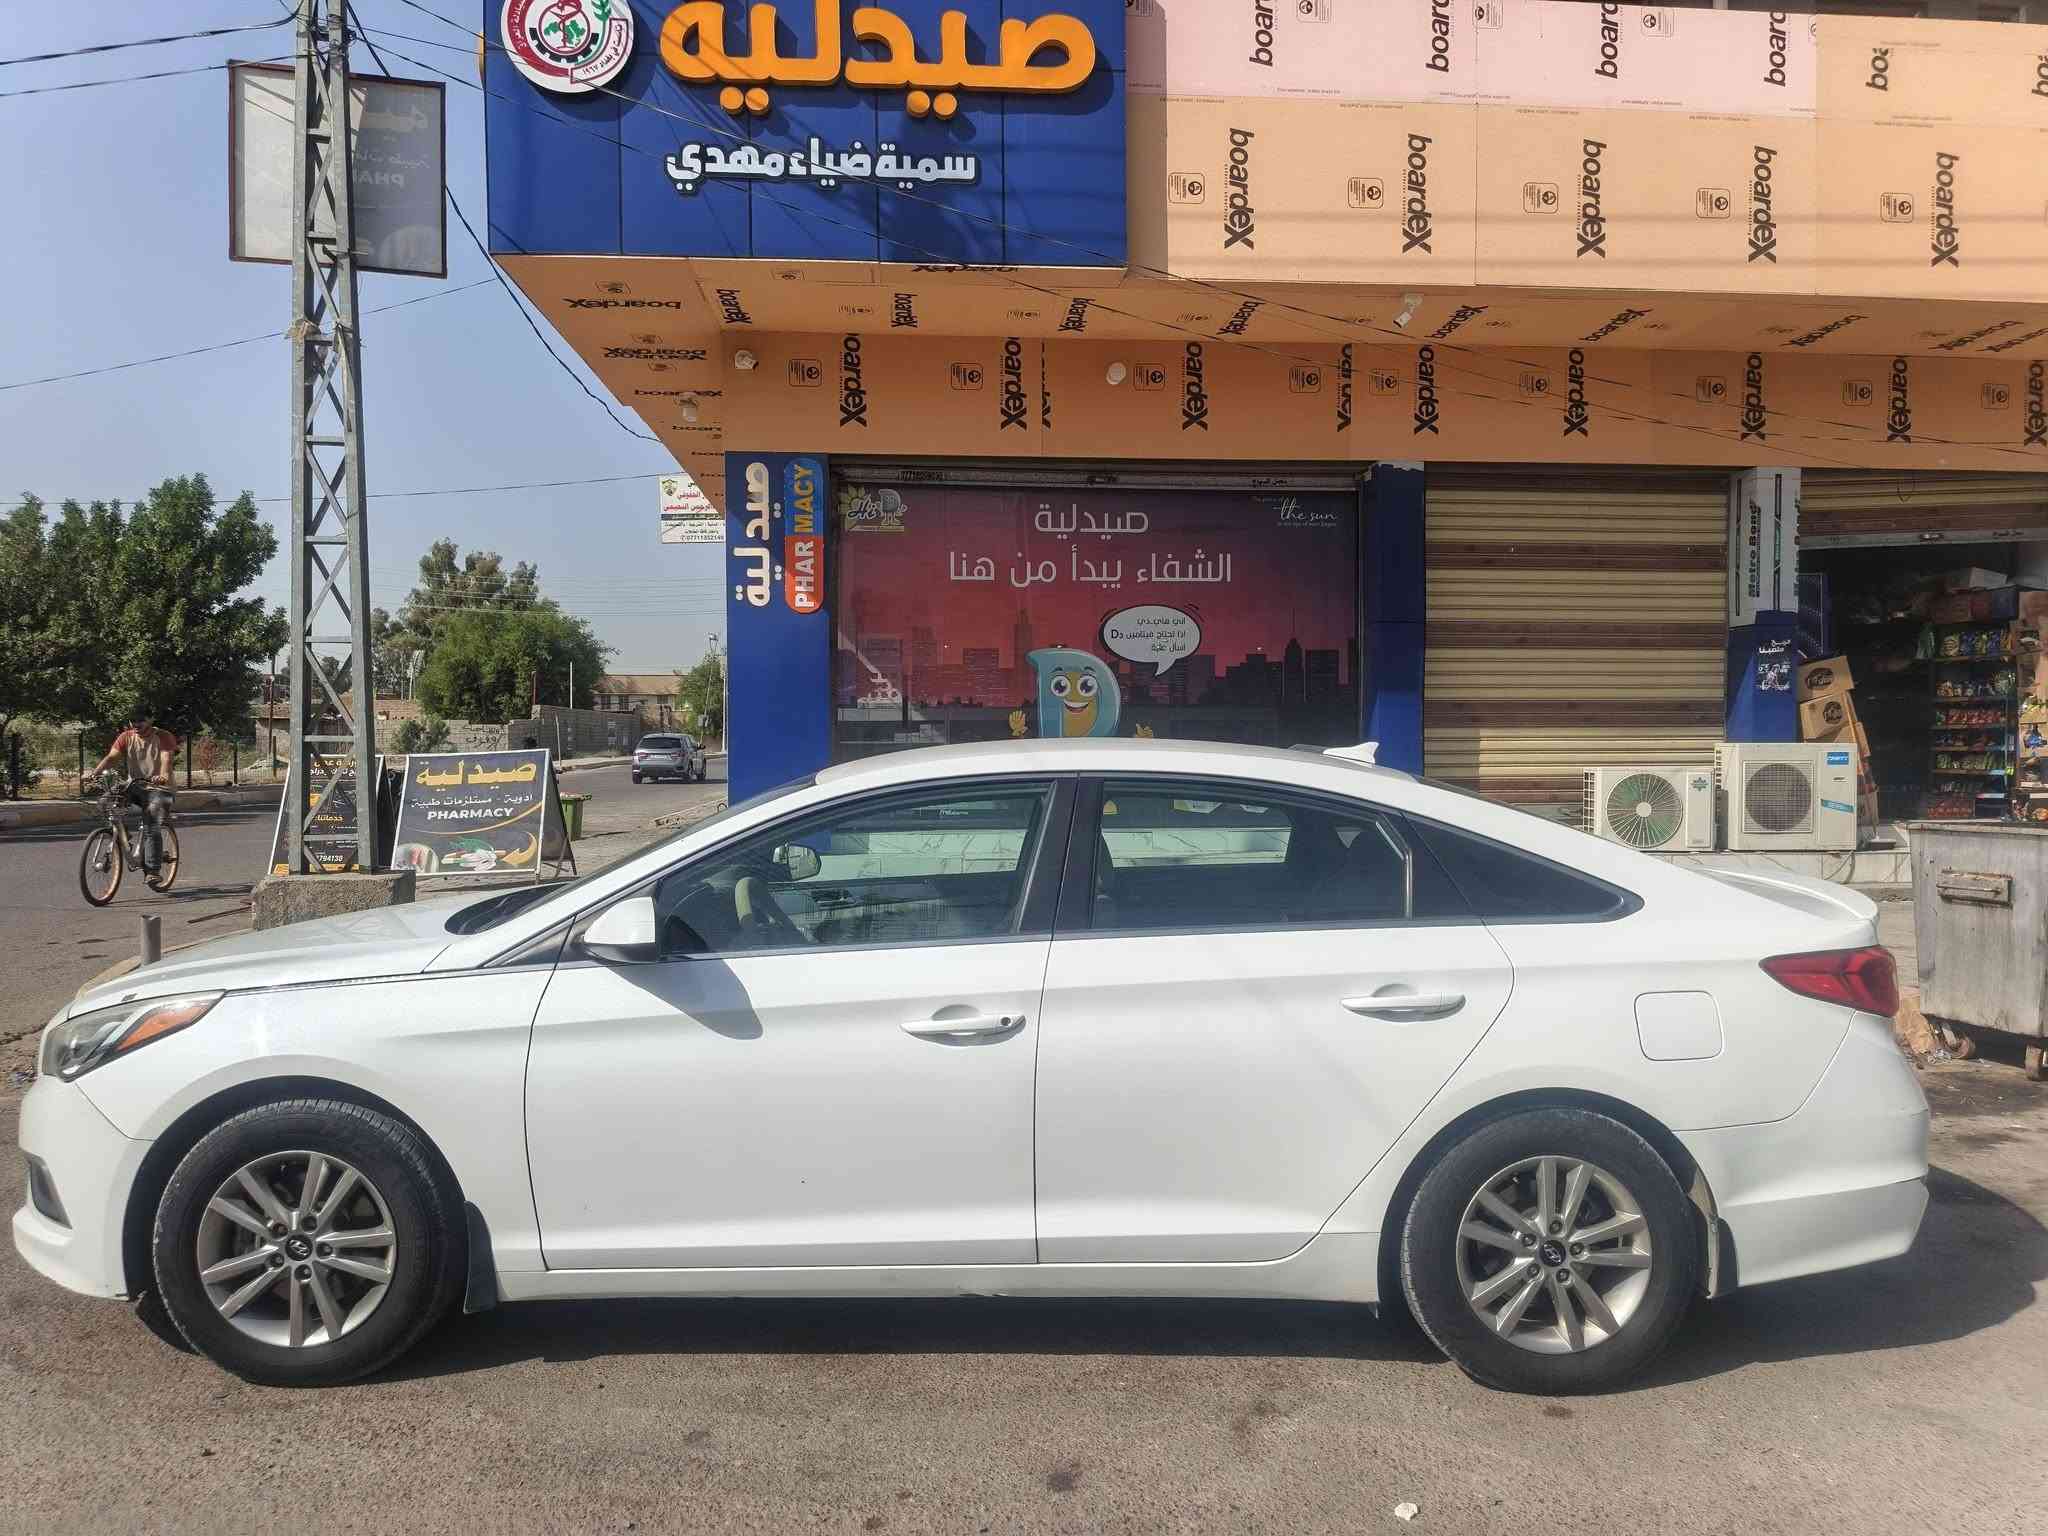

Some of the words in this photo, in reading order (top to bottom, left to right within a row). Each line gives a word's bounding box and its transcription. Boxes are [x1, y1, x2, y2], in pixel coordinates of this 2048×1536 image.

[1250, 0, 1273, 66] boar
[667, 141, 784, 191] مهدي
[790, 138, 872, 187] ضياء
[876, 142, 976, 190] سمية
[842, 333, 866, 426] oardeX
[1001, 337, 1026, 429] oardeX
[1184, 342, 1207, 430] oardeX
[1415, 345, 1438, 434] oardeX
[1565, 348, 1588, 436] oardeX
[1741, 352, 1765, 440] oardeX
[1888, 355, 1911, 443] oardeX
[2024, 360, 2048, 446] oardeX
[733, 462, 782, 607] صيدلية
[1035, 503, 1149, 540] صيدلية
[950, 551, 995, 581] هنا
[1010, 552, 1057, 588] من
[1071, 544, 1122, 589] يبدأ
[1137, 548, 1231, 583] الشفاء
[415, 759, 537, 792] صيدلية
[427, 807, 514, 821] PHARMACY
